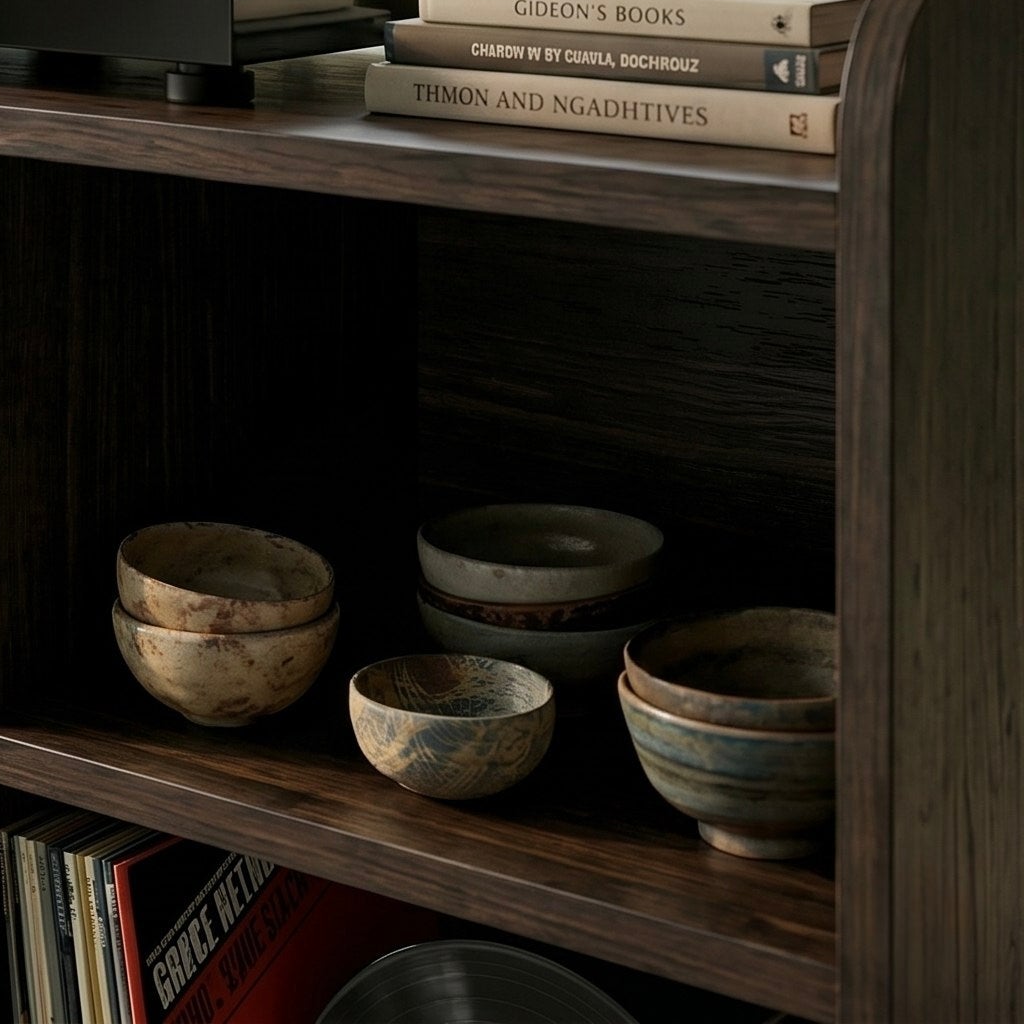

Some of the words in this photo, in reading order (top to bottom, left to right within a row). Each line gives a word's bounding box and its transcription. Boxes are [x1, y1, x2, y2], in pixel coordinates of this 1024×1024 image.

[514, 0, 607, 21] GIDEON'S
[616, 5, 685, 26] BOOKS
[545, 48, 562, 62] BY
[413, 83, 489, 106] THMON
[496, 91, 544, 111] AND
[553, 95, 709, 126] NGADHTIVES
